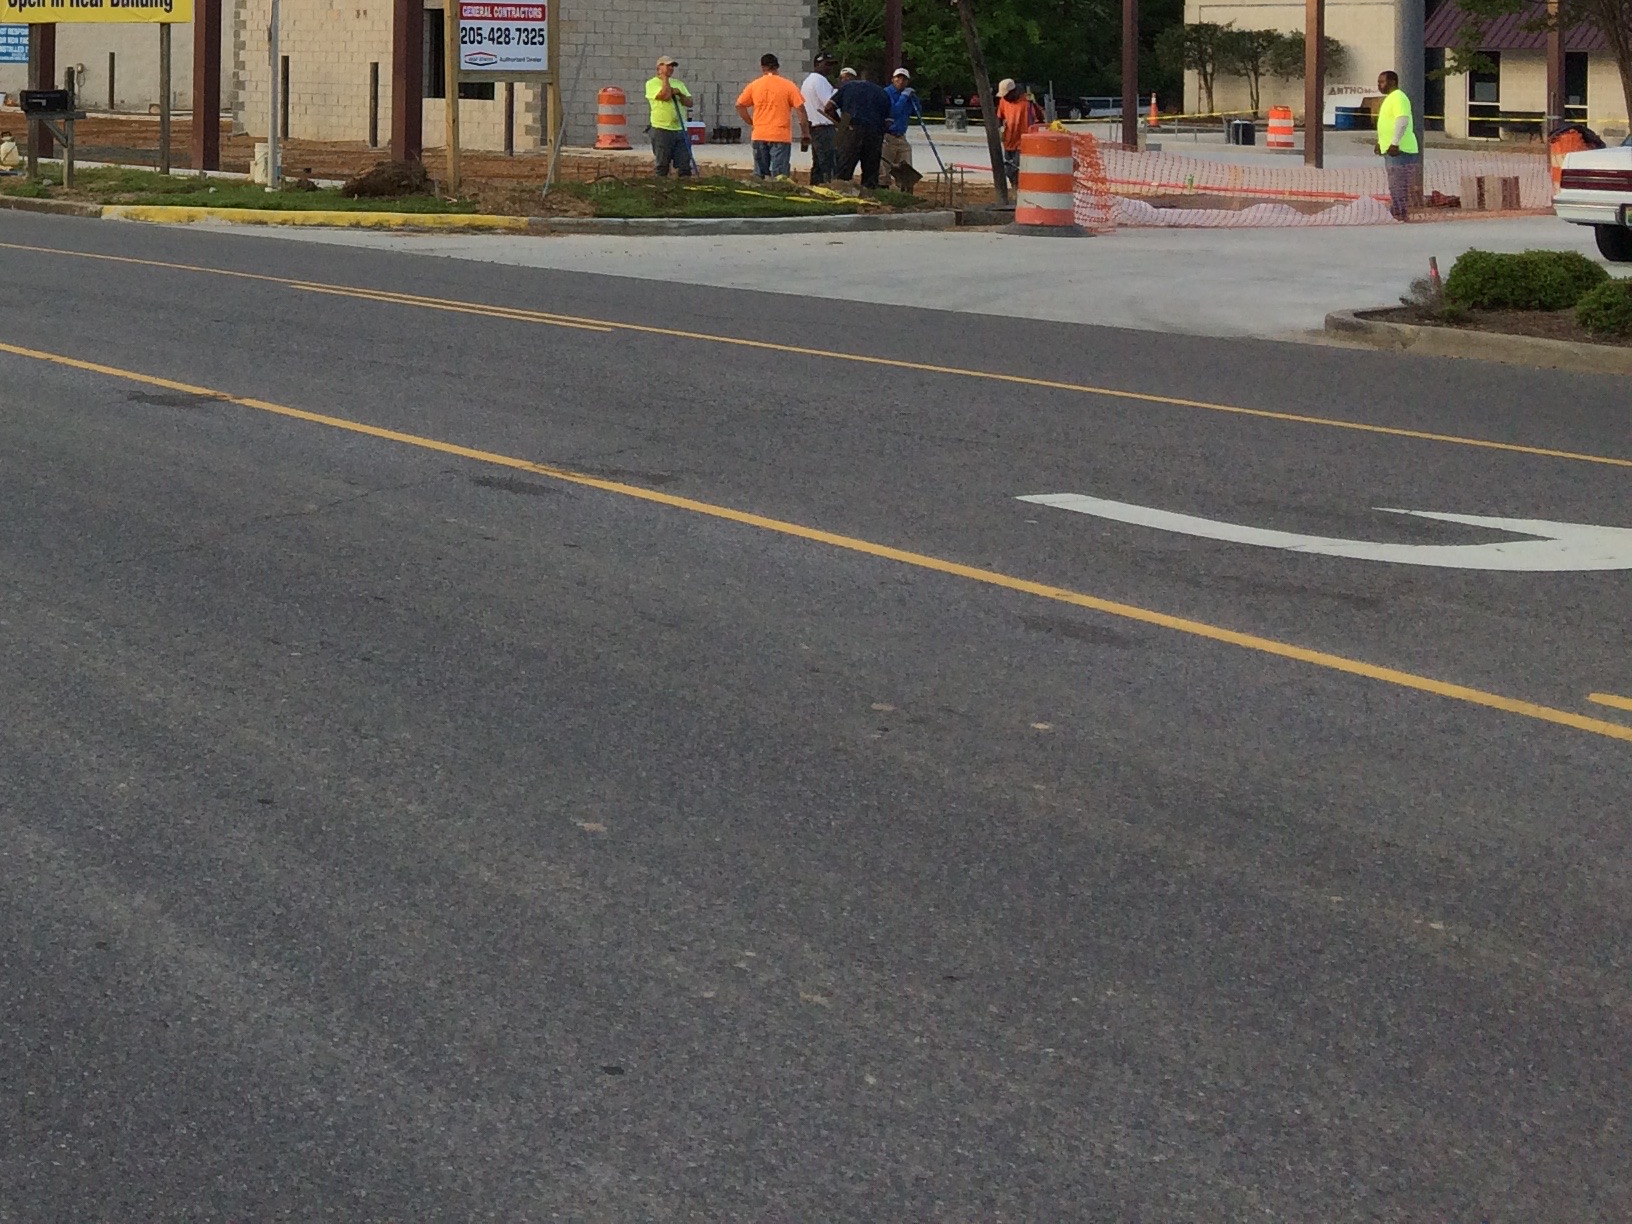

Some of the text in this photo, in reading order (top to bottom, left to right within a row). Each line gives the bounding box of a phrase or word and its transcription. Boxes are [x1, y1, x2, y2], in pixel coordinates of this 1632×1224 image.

[462, 6, 543, 18] GENERAL CONTRACTORS
[460, 26, 545, 46] 205-428-7325
